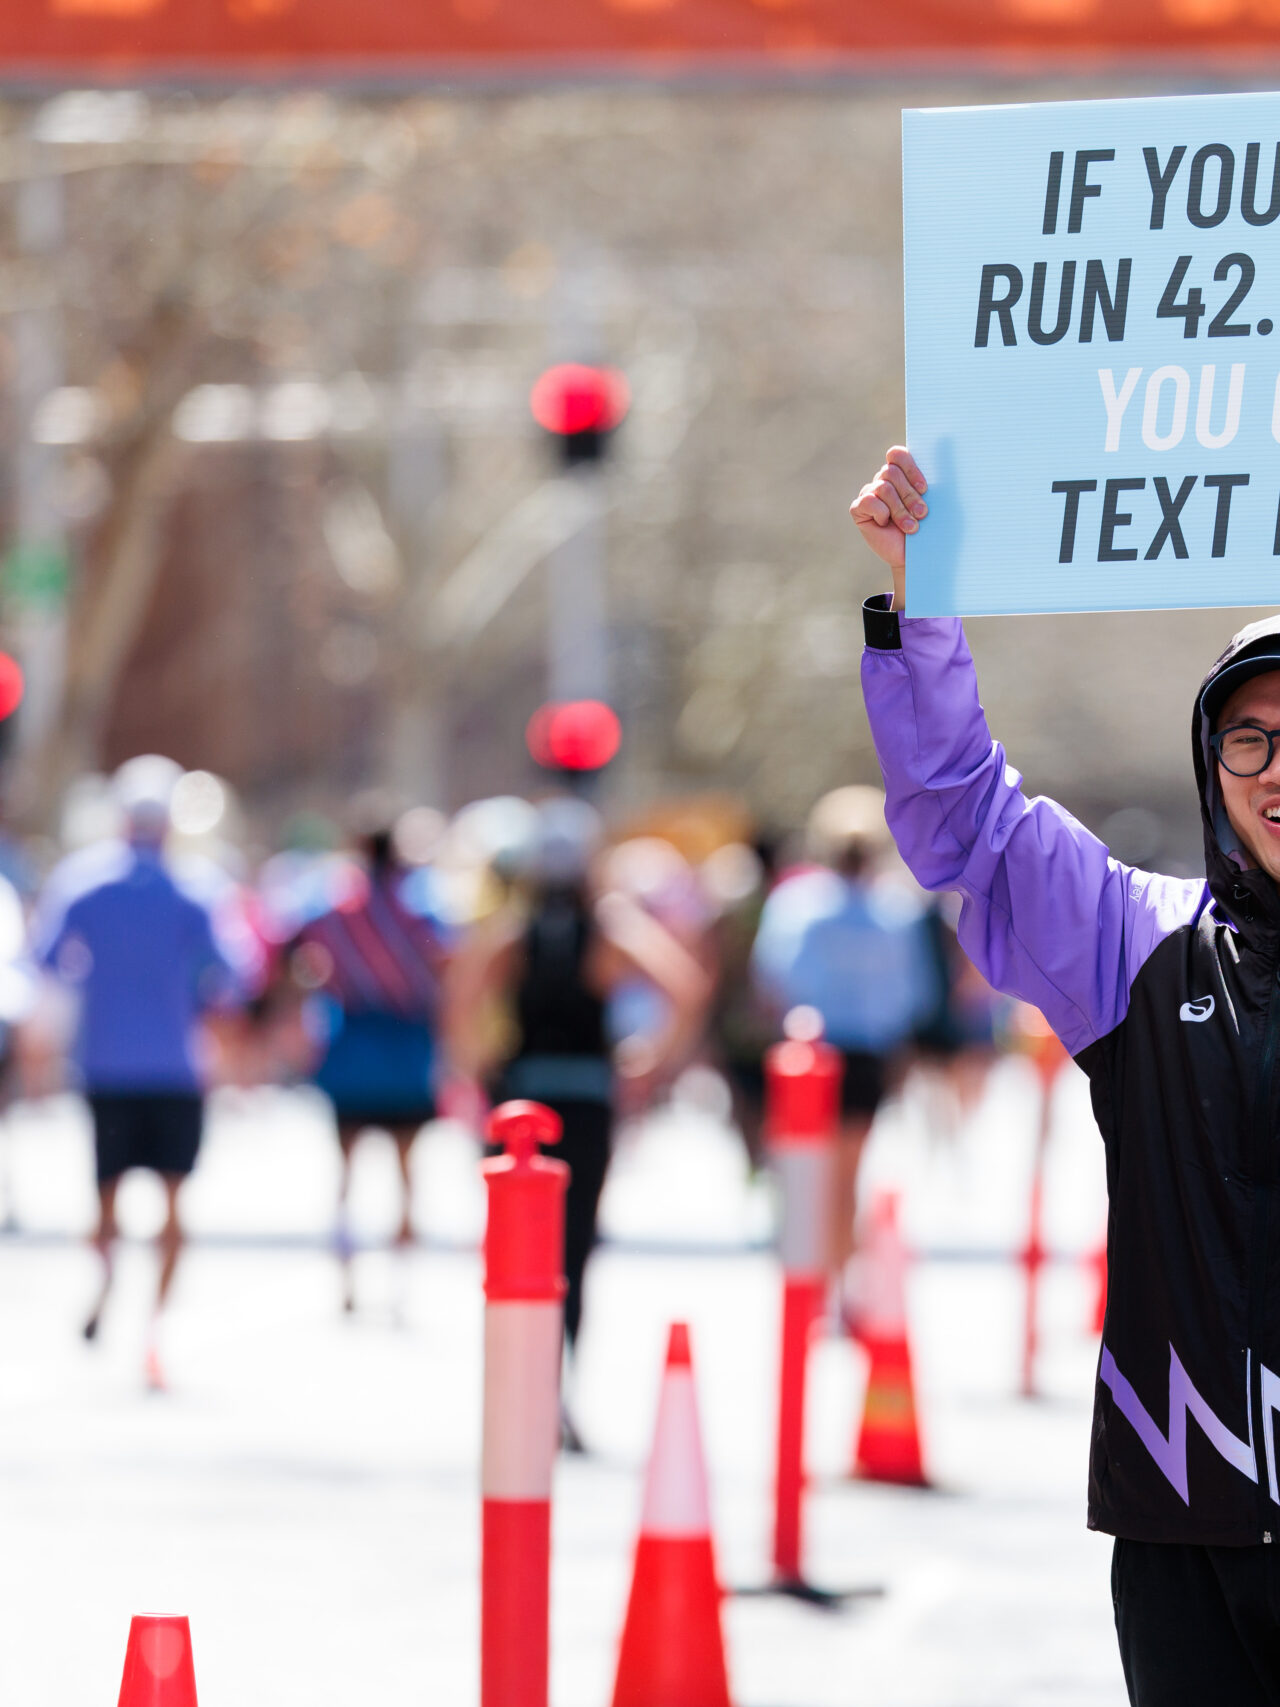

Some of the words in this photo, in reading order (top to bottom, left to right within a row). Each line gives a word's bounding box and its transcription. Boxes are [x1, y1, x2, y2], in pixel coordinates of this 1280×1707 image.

[1043, 149, 1115, 234] IF
[975, 258, 1132, 347] RUN
[1098, 360, 1245, 451] YOU
[1052, 474, 1250, 563] TEXT
